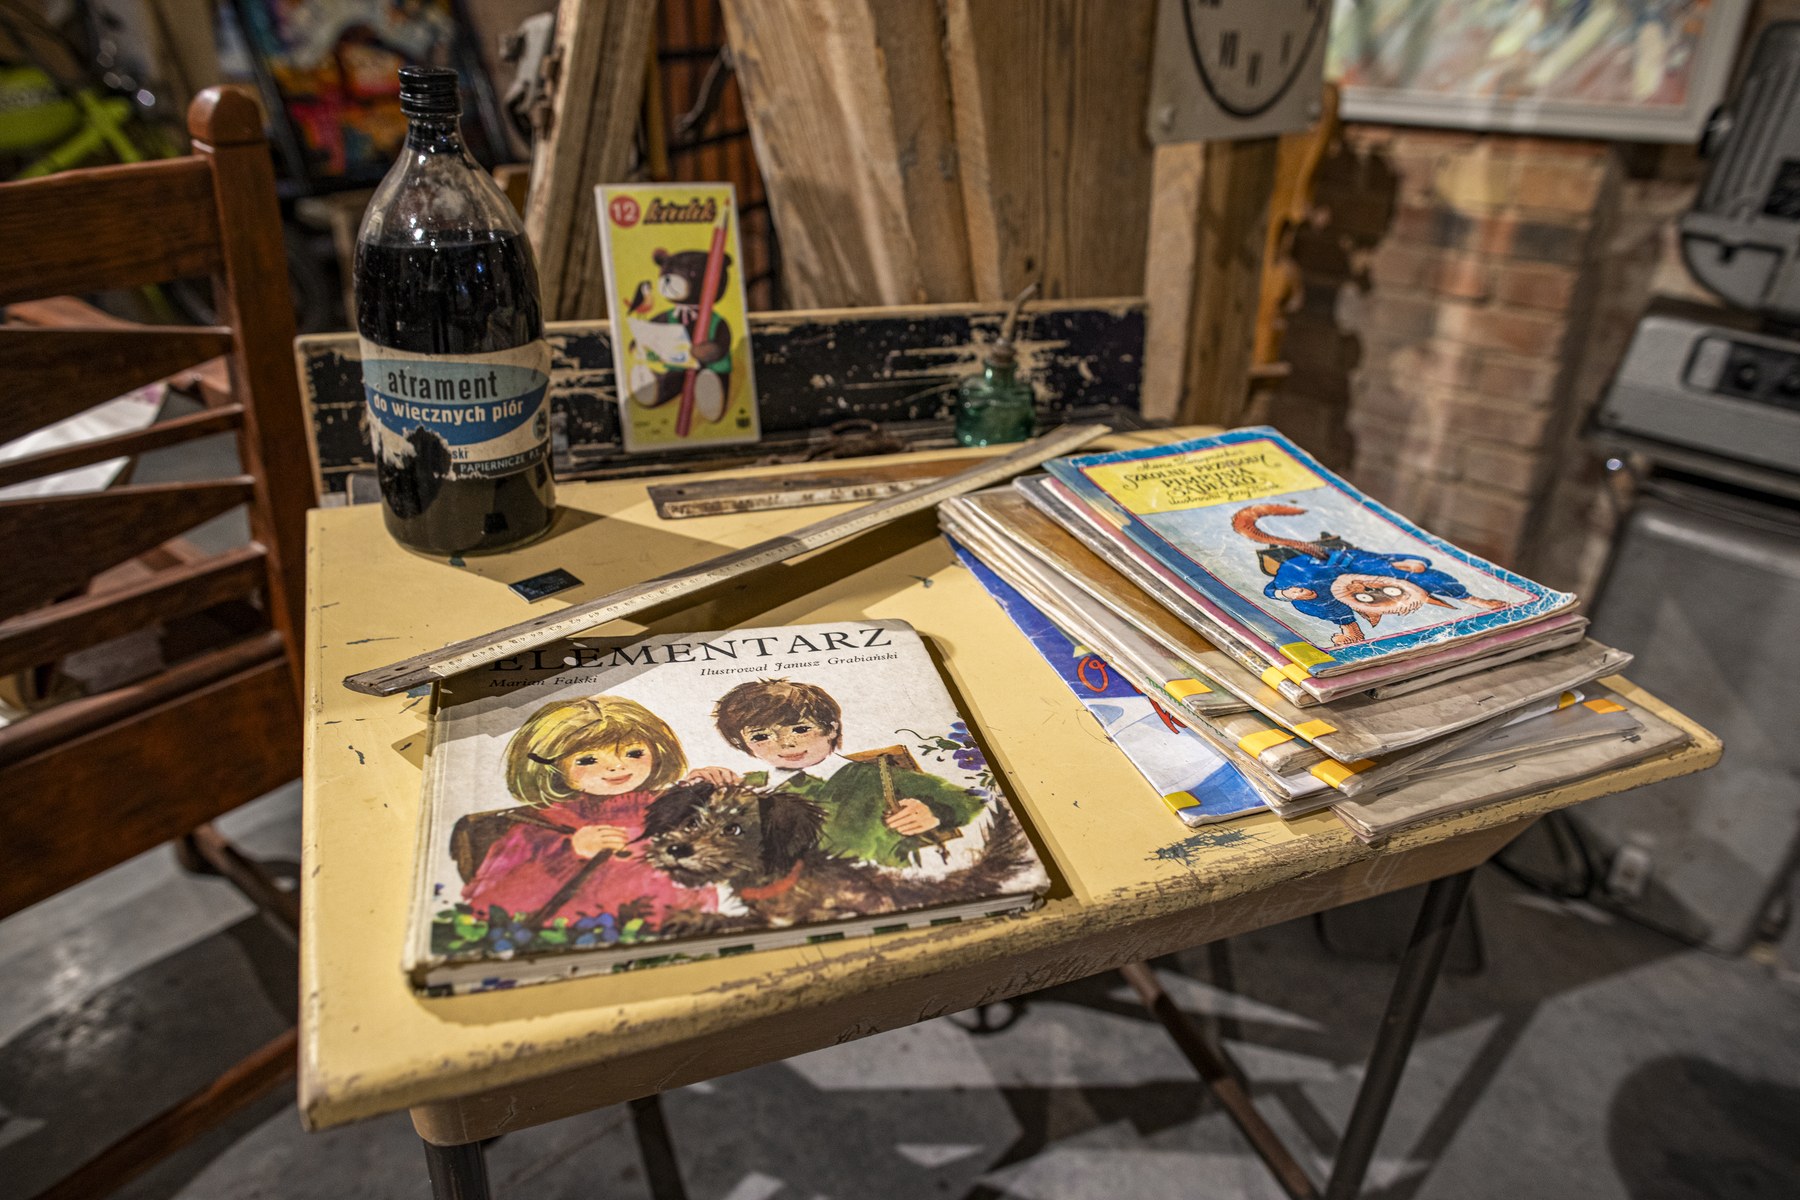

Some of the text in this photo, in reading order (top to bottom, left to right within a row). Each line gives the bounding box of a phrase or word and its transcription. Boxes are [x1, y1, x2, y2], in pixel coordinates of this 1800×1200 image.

[612, 201, 638, 224] 12
[388, 369, 498, 400] atrament
[374, 393, 524, 426] do wiecznych piór
[459, 455, 526, 473] PAPIERNICZE
[488, 627, 893, 672] ELEMENTARZ
[699, 650, 899, 677] Ilustrował Janusz Grabiański
[488, 674, 598, 688] Marian Falski
